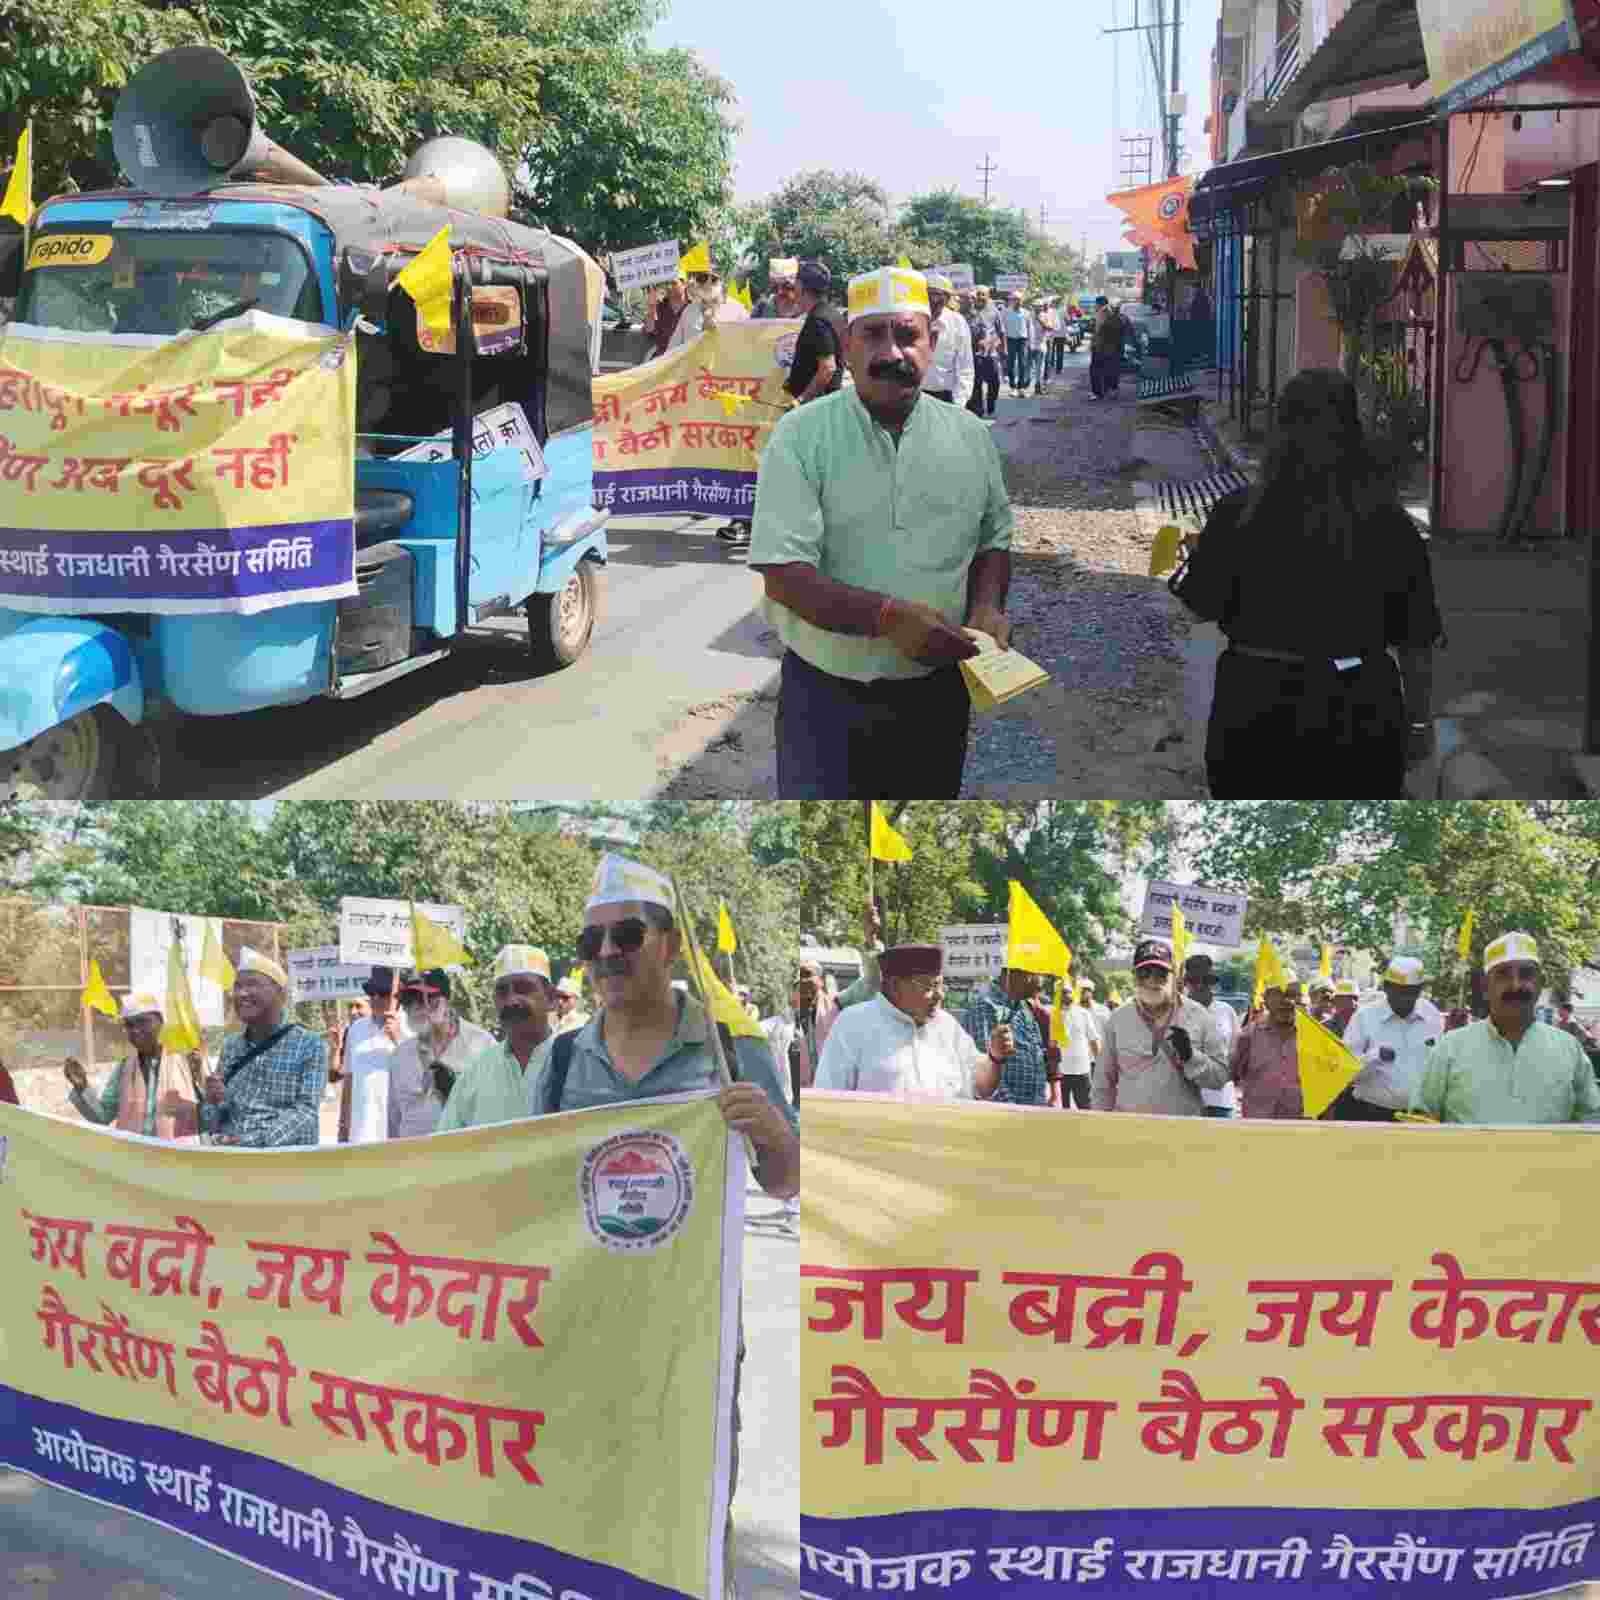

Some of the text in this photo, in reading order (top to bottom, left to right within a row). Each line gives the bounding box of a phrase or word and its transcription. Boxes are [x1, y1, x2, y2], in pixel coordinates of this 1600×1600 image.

[34, 237, 94, 257] rapido
[679, 420, 761, 451] सरकार
[53, 545, 151, 577] राजधानी
[155, 542, 241, 577] गैरसैंण
[245, 536, 313, 575] समिति
[22, 1207, 95, 1280] जय
[246, 1240, 352, 1316] जय
[364, 1231, 551, 1347] केदार
[800, 1264, 980, 1345] जय
[1245, 1279, 1394, 1347] जय
[36, 1284, 546, 1486] गैरसैंण बैठो सरकार
[813, 1364, 1593, 1465] गैरसैंण बैठो सरकार
[32, 1426, 137, 1486] आयोजक
[140, 1462, 211, 1513] स्थाई
[217, 1482, 336, 1562] राजधानी
[340, 1515, 460, 1600] गैरसैंण
[800, 1522, 1596, 1591] योजक स्थाई राजधानी गैरसैंण समिति
